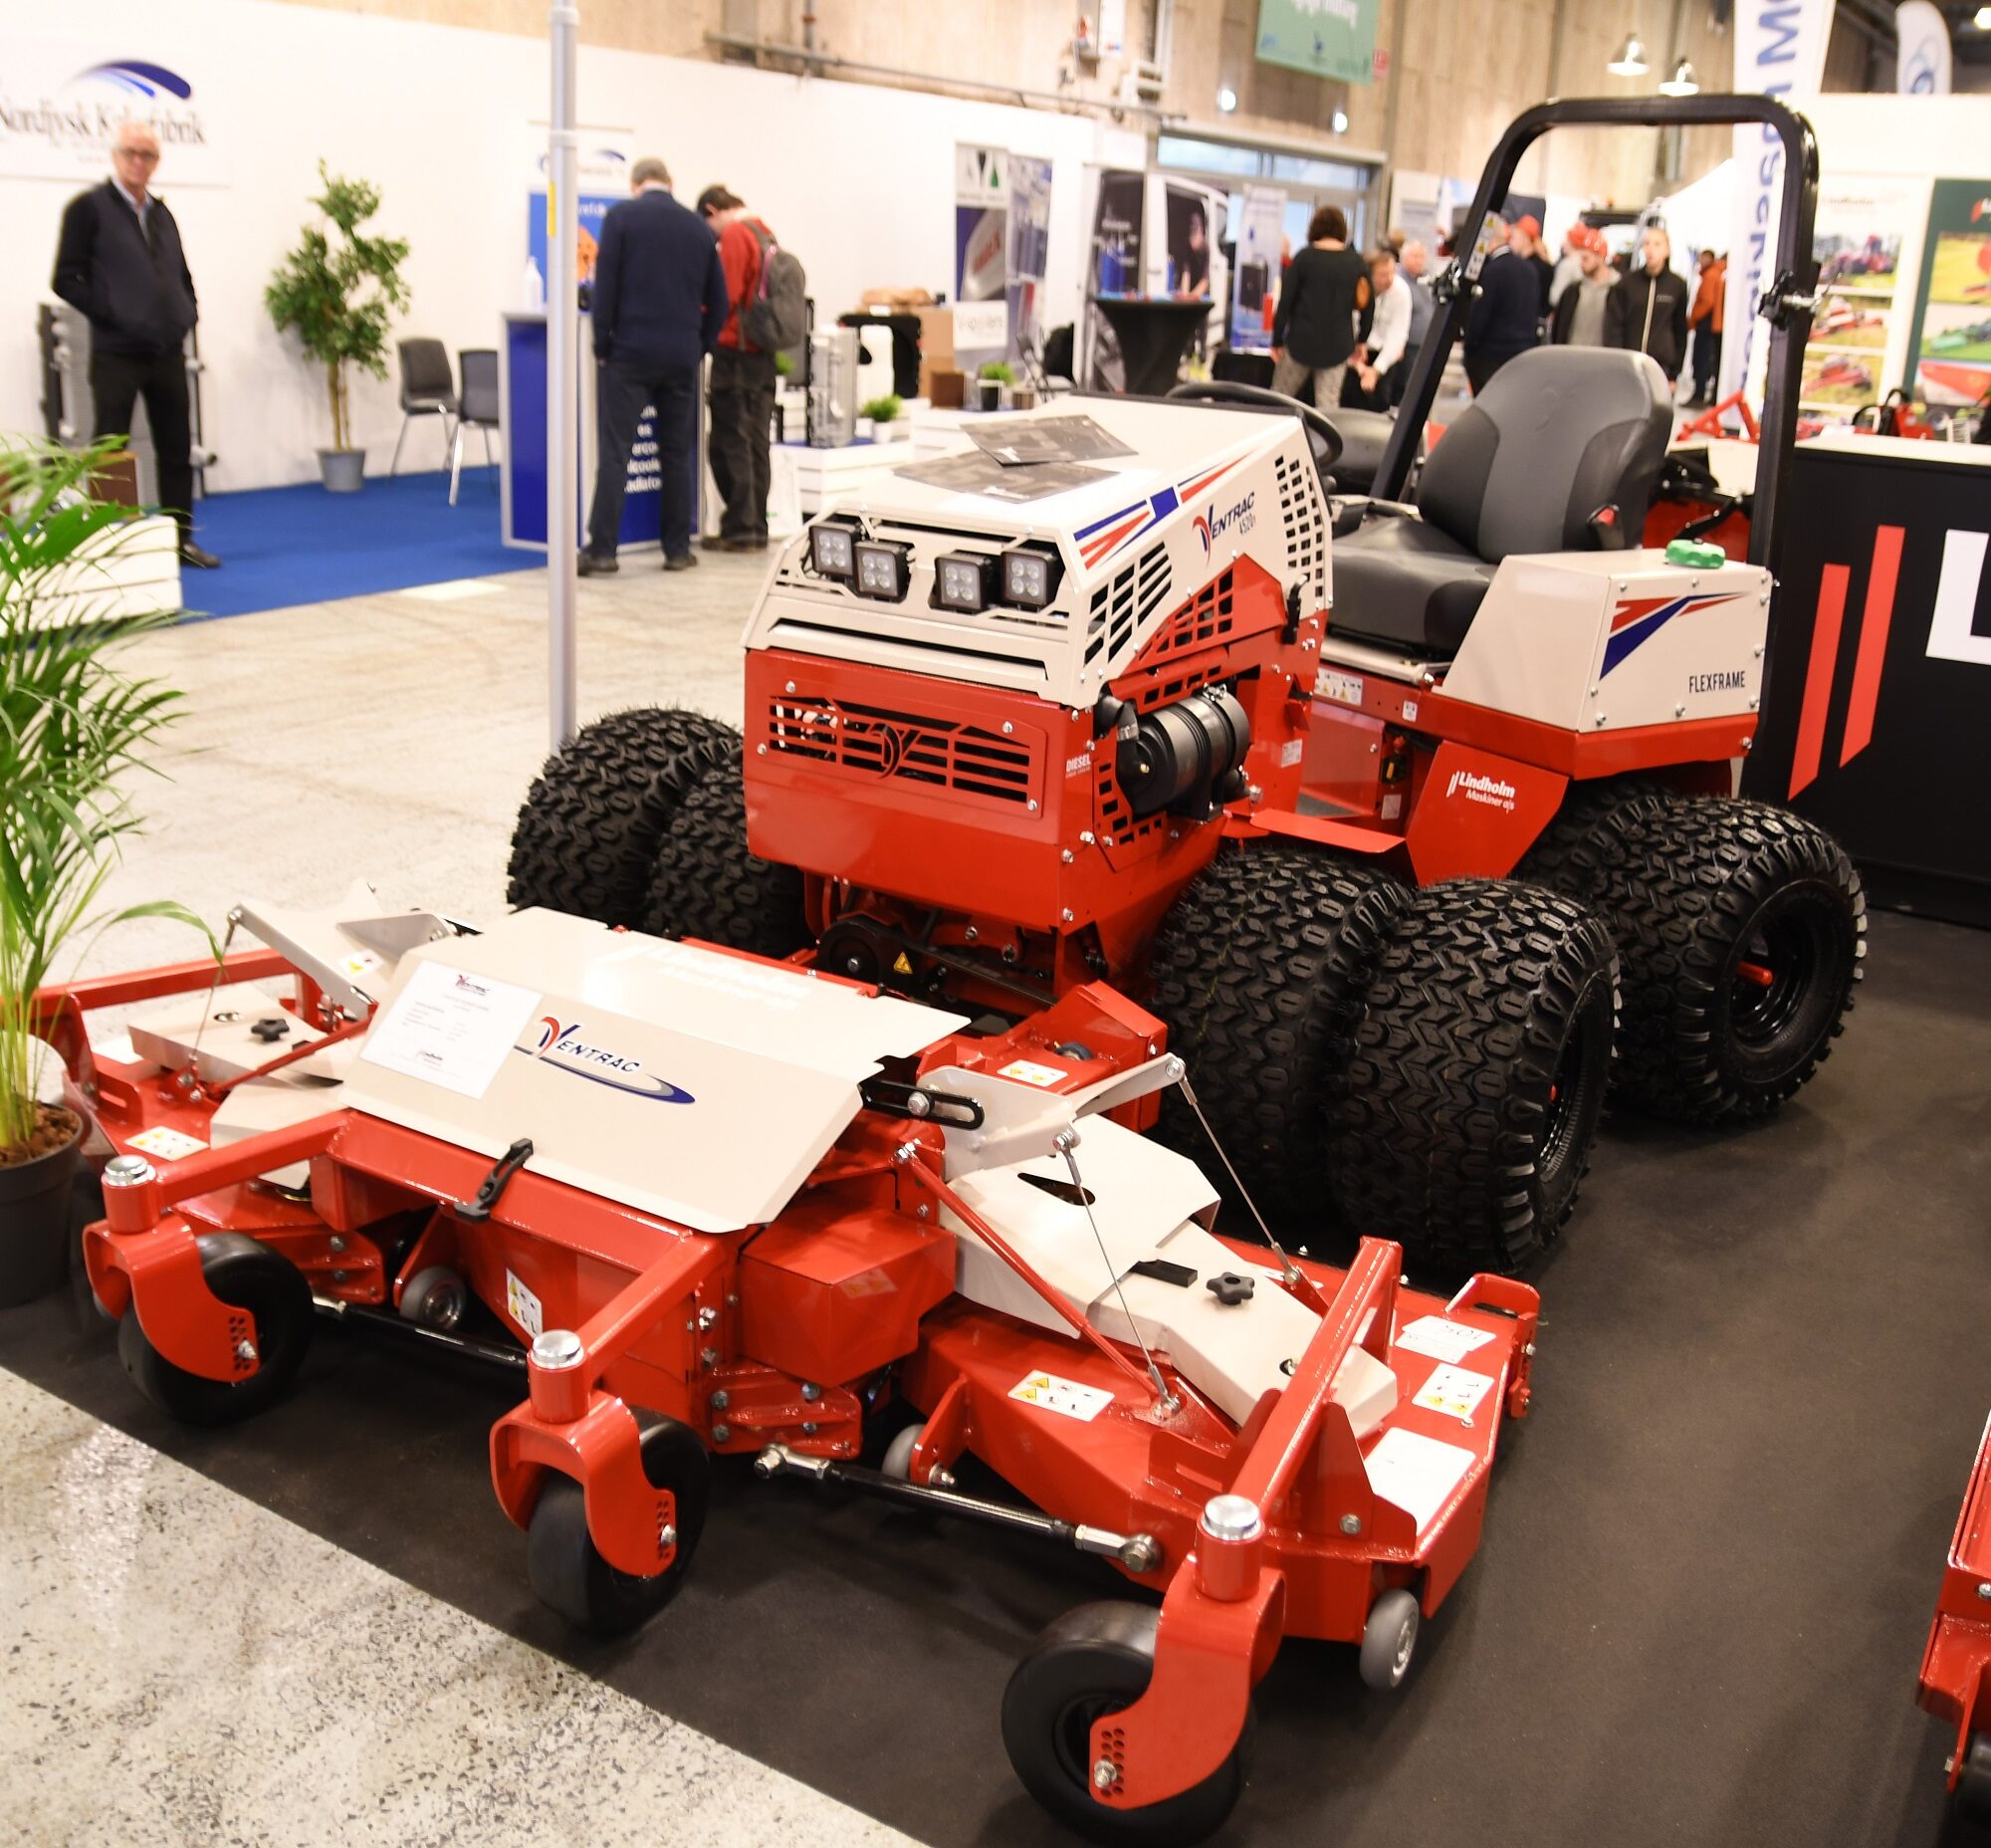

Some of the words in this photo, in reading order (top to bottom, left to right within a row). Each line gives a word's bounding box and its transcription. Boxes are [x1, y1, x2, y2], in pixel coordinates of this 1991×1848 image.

[1192, 491, 1255, 567] VENTRAC
[1688, 670, 1746, 694] FLEXFRAME
[1066, 753, 1091, 774] DIESEL
[1458, 771, 1515, 799] Lindholm
[1465, 789, 1503, 808] Maskiner
[539, 1016, 641, 1073] VENTRAC
